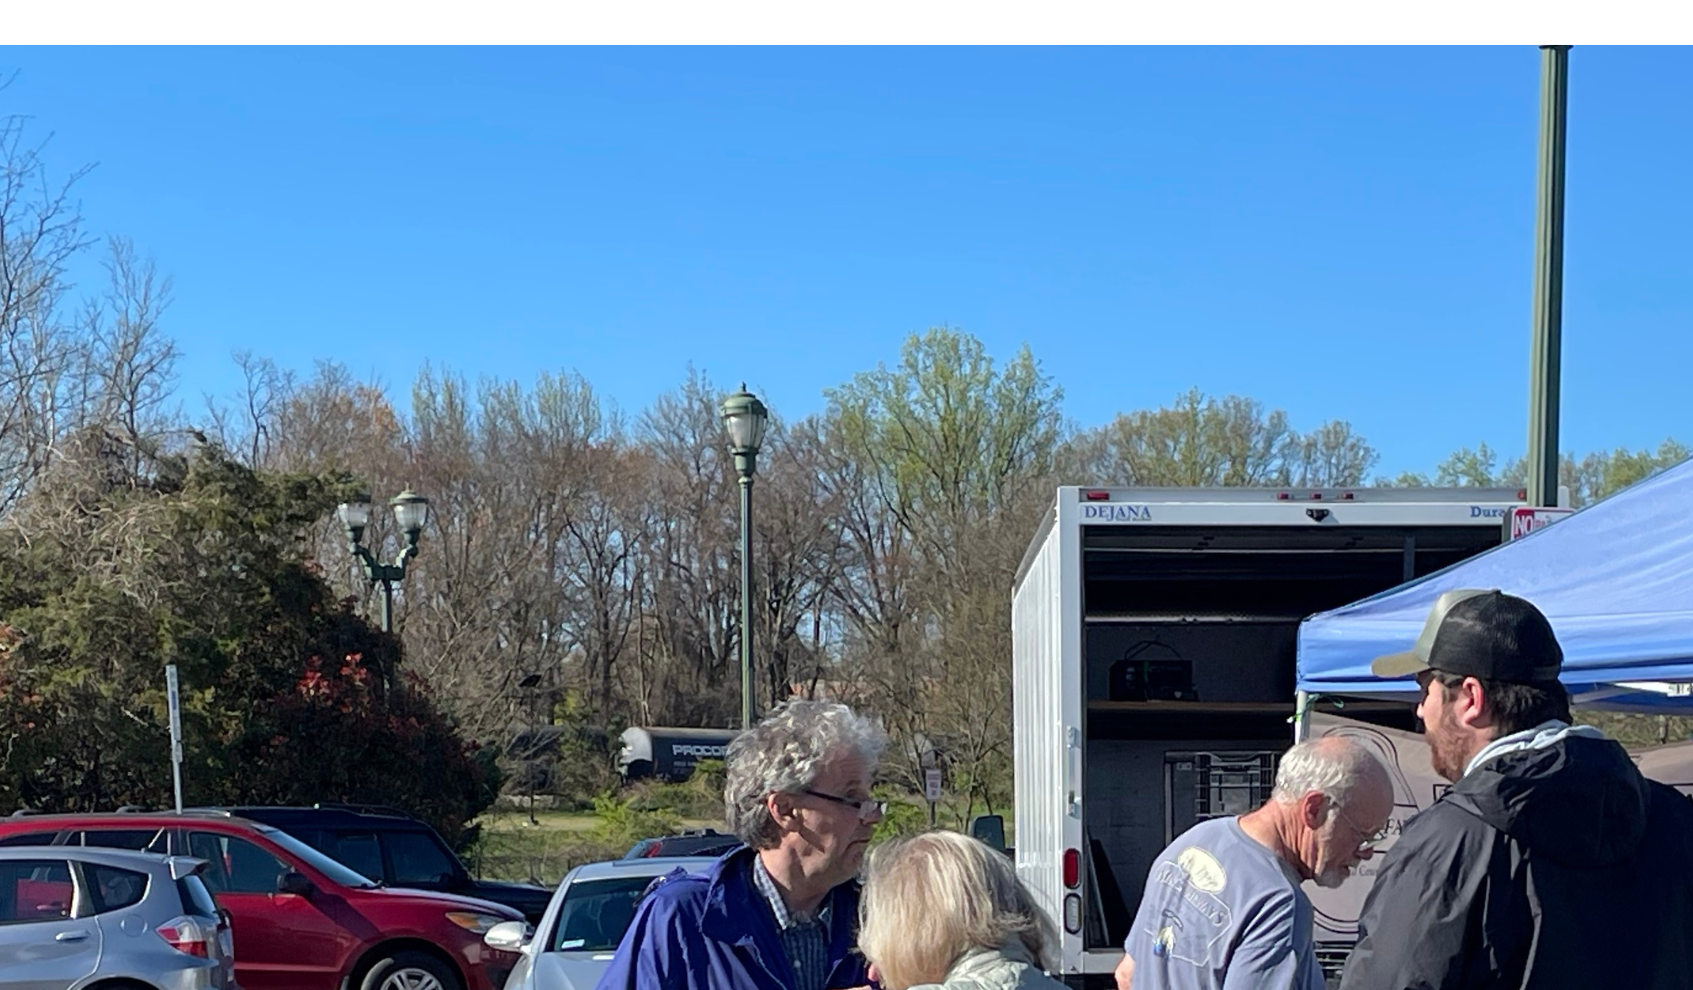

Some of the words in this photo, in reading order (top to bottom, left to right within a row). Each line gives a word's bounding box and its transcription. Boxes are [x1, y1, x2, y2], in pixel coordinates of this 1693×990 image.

[1084, 505, 1152, 522] DEJANA
[1469, 506, 1506, 518] Dura
[1514, 514, 1534, 537] NO
